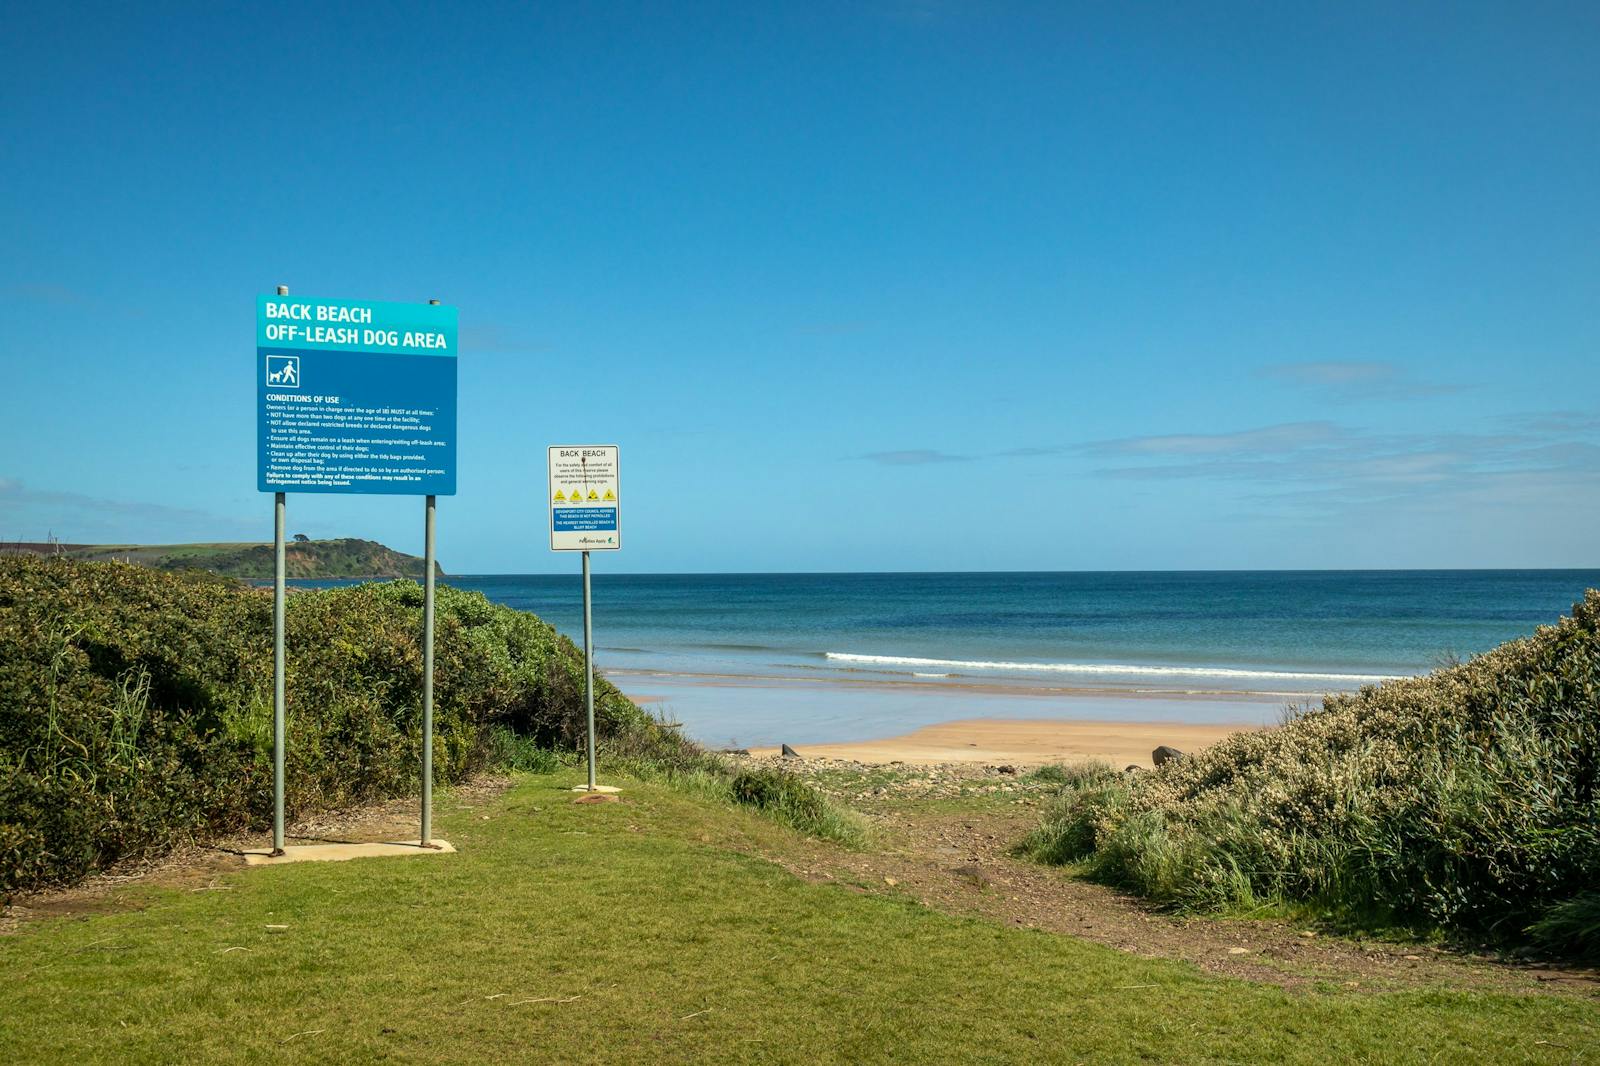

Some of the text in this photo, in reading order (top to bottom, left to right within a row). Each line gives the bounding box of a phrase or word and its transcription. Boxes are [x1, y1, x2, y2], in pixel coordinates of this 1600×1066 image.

[266, 303, 372, 323] BACK BEACH
[266, 324, 447, 349] OFF-LEASH DOG AREA
[266, 394, 311, 402] CONDITIONS
